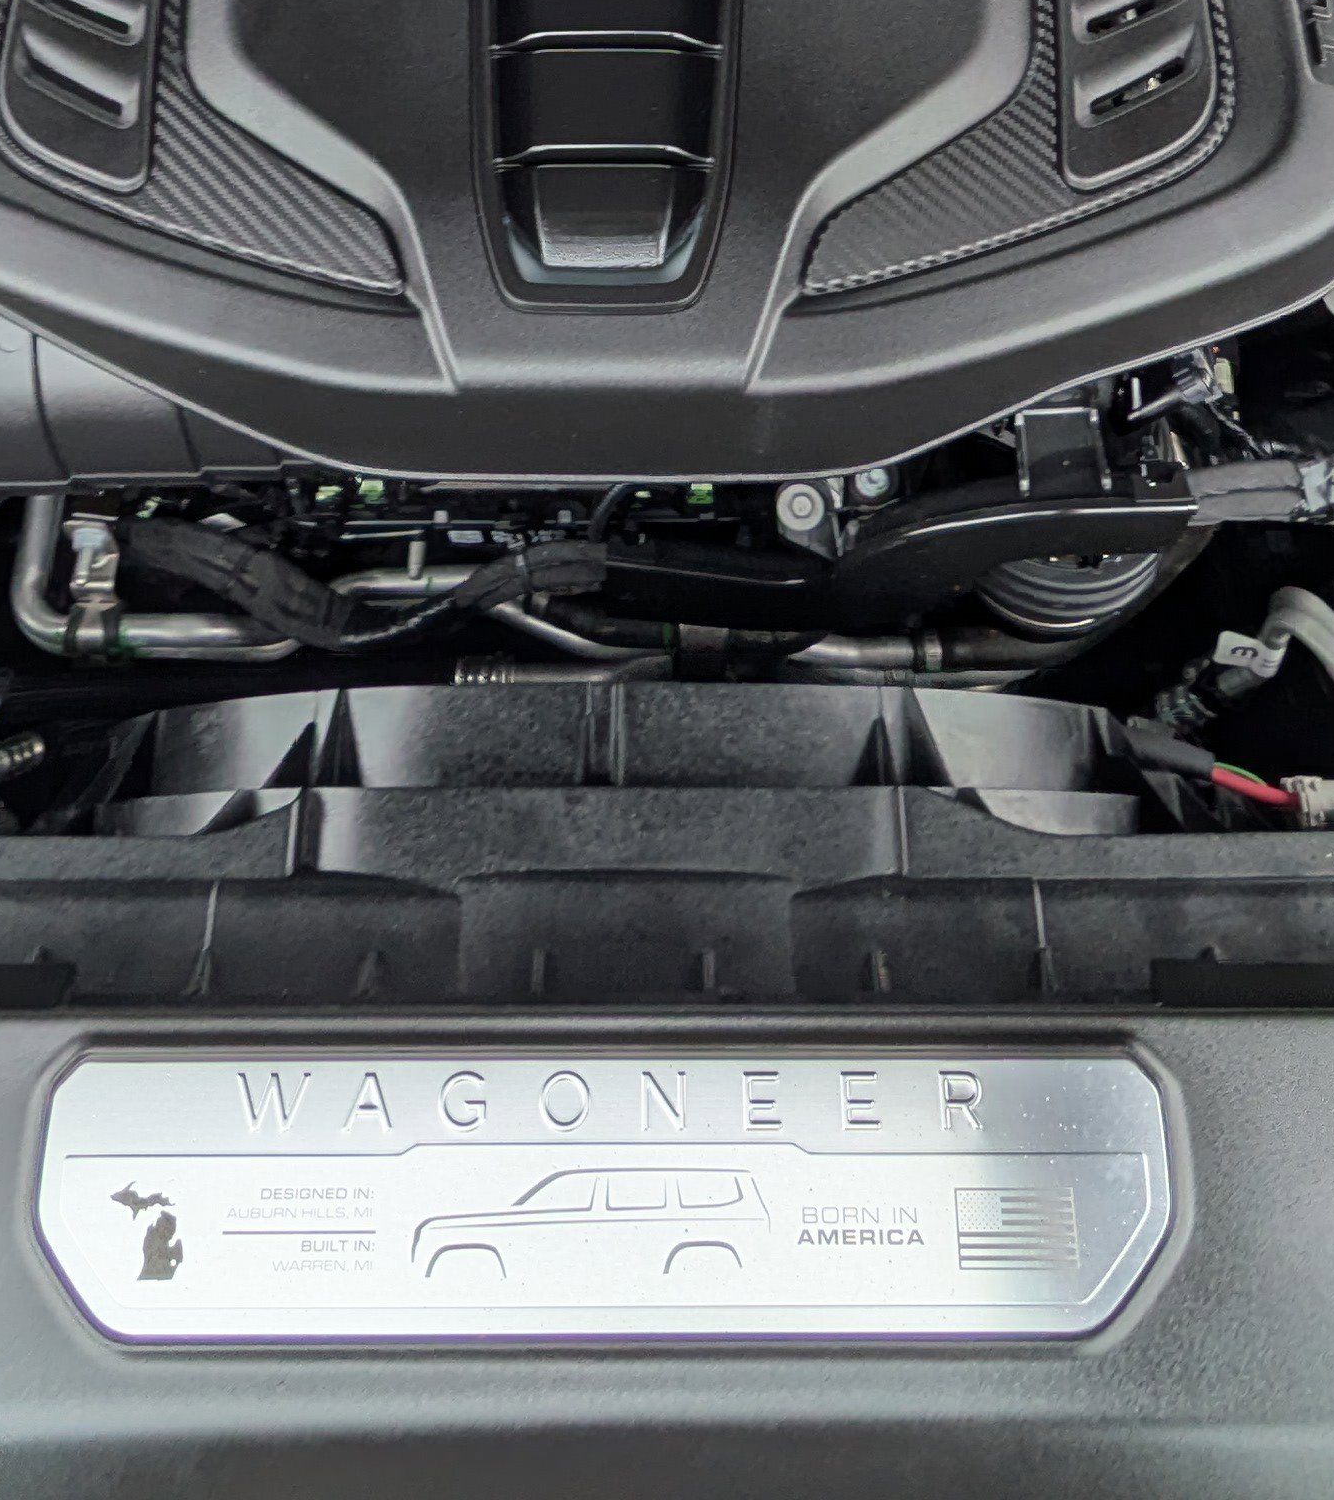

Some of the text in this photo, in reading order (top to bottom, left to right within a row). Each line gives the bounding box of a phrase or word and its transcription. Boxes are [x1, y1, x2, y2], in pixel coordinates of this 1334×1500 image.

[235, 1069, 985, 1133] WAGONEER
[260, 1187, 375, 1200] DESIGNED IN:
[227, 1206, 373, 1220] AUBURN HILLS, MI
[802, 1206, 918, 1224] BORN IN
[797, 1228, 925, 1246] AMERICA
[300, 1239, 375, 1252] BUILT IN:
[272, 1259, 373, 1273] WARREN, MI
